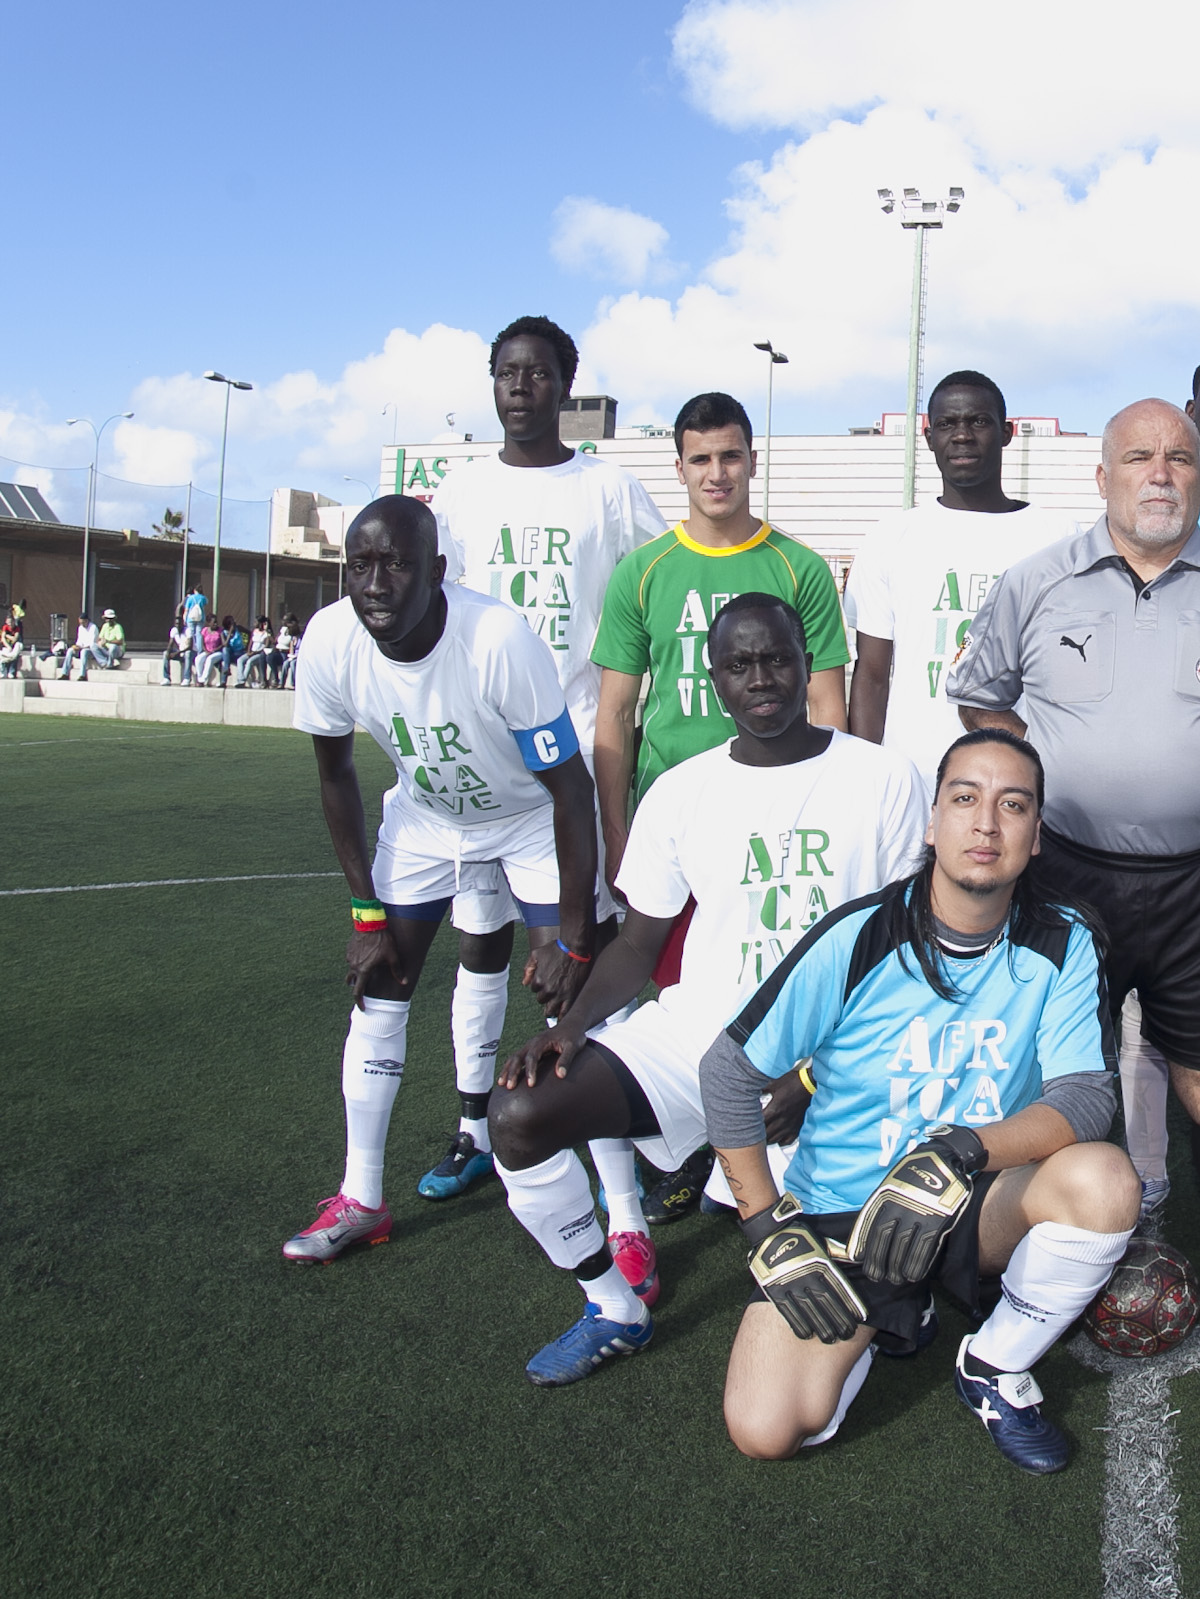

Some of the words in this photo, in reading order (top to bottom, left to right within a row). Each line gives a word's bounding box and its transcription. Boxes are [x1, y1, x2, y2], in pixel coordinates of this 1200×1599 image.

[487, 523, 573, 566] ÁFR
[676, 589, 741, 632] ÁF
[932, 568, 1000, 612] ÁF
[533, 729, 560, 764] C
[414, 763, 488, 794] CA
[740, 828, 834, 885] ÁFR
[886, 1016, 1010, 1073] ÁFR
[886, 1075, 1004, 1123] ICA
